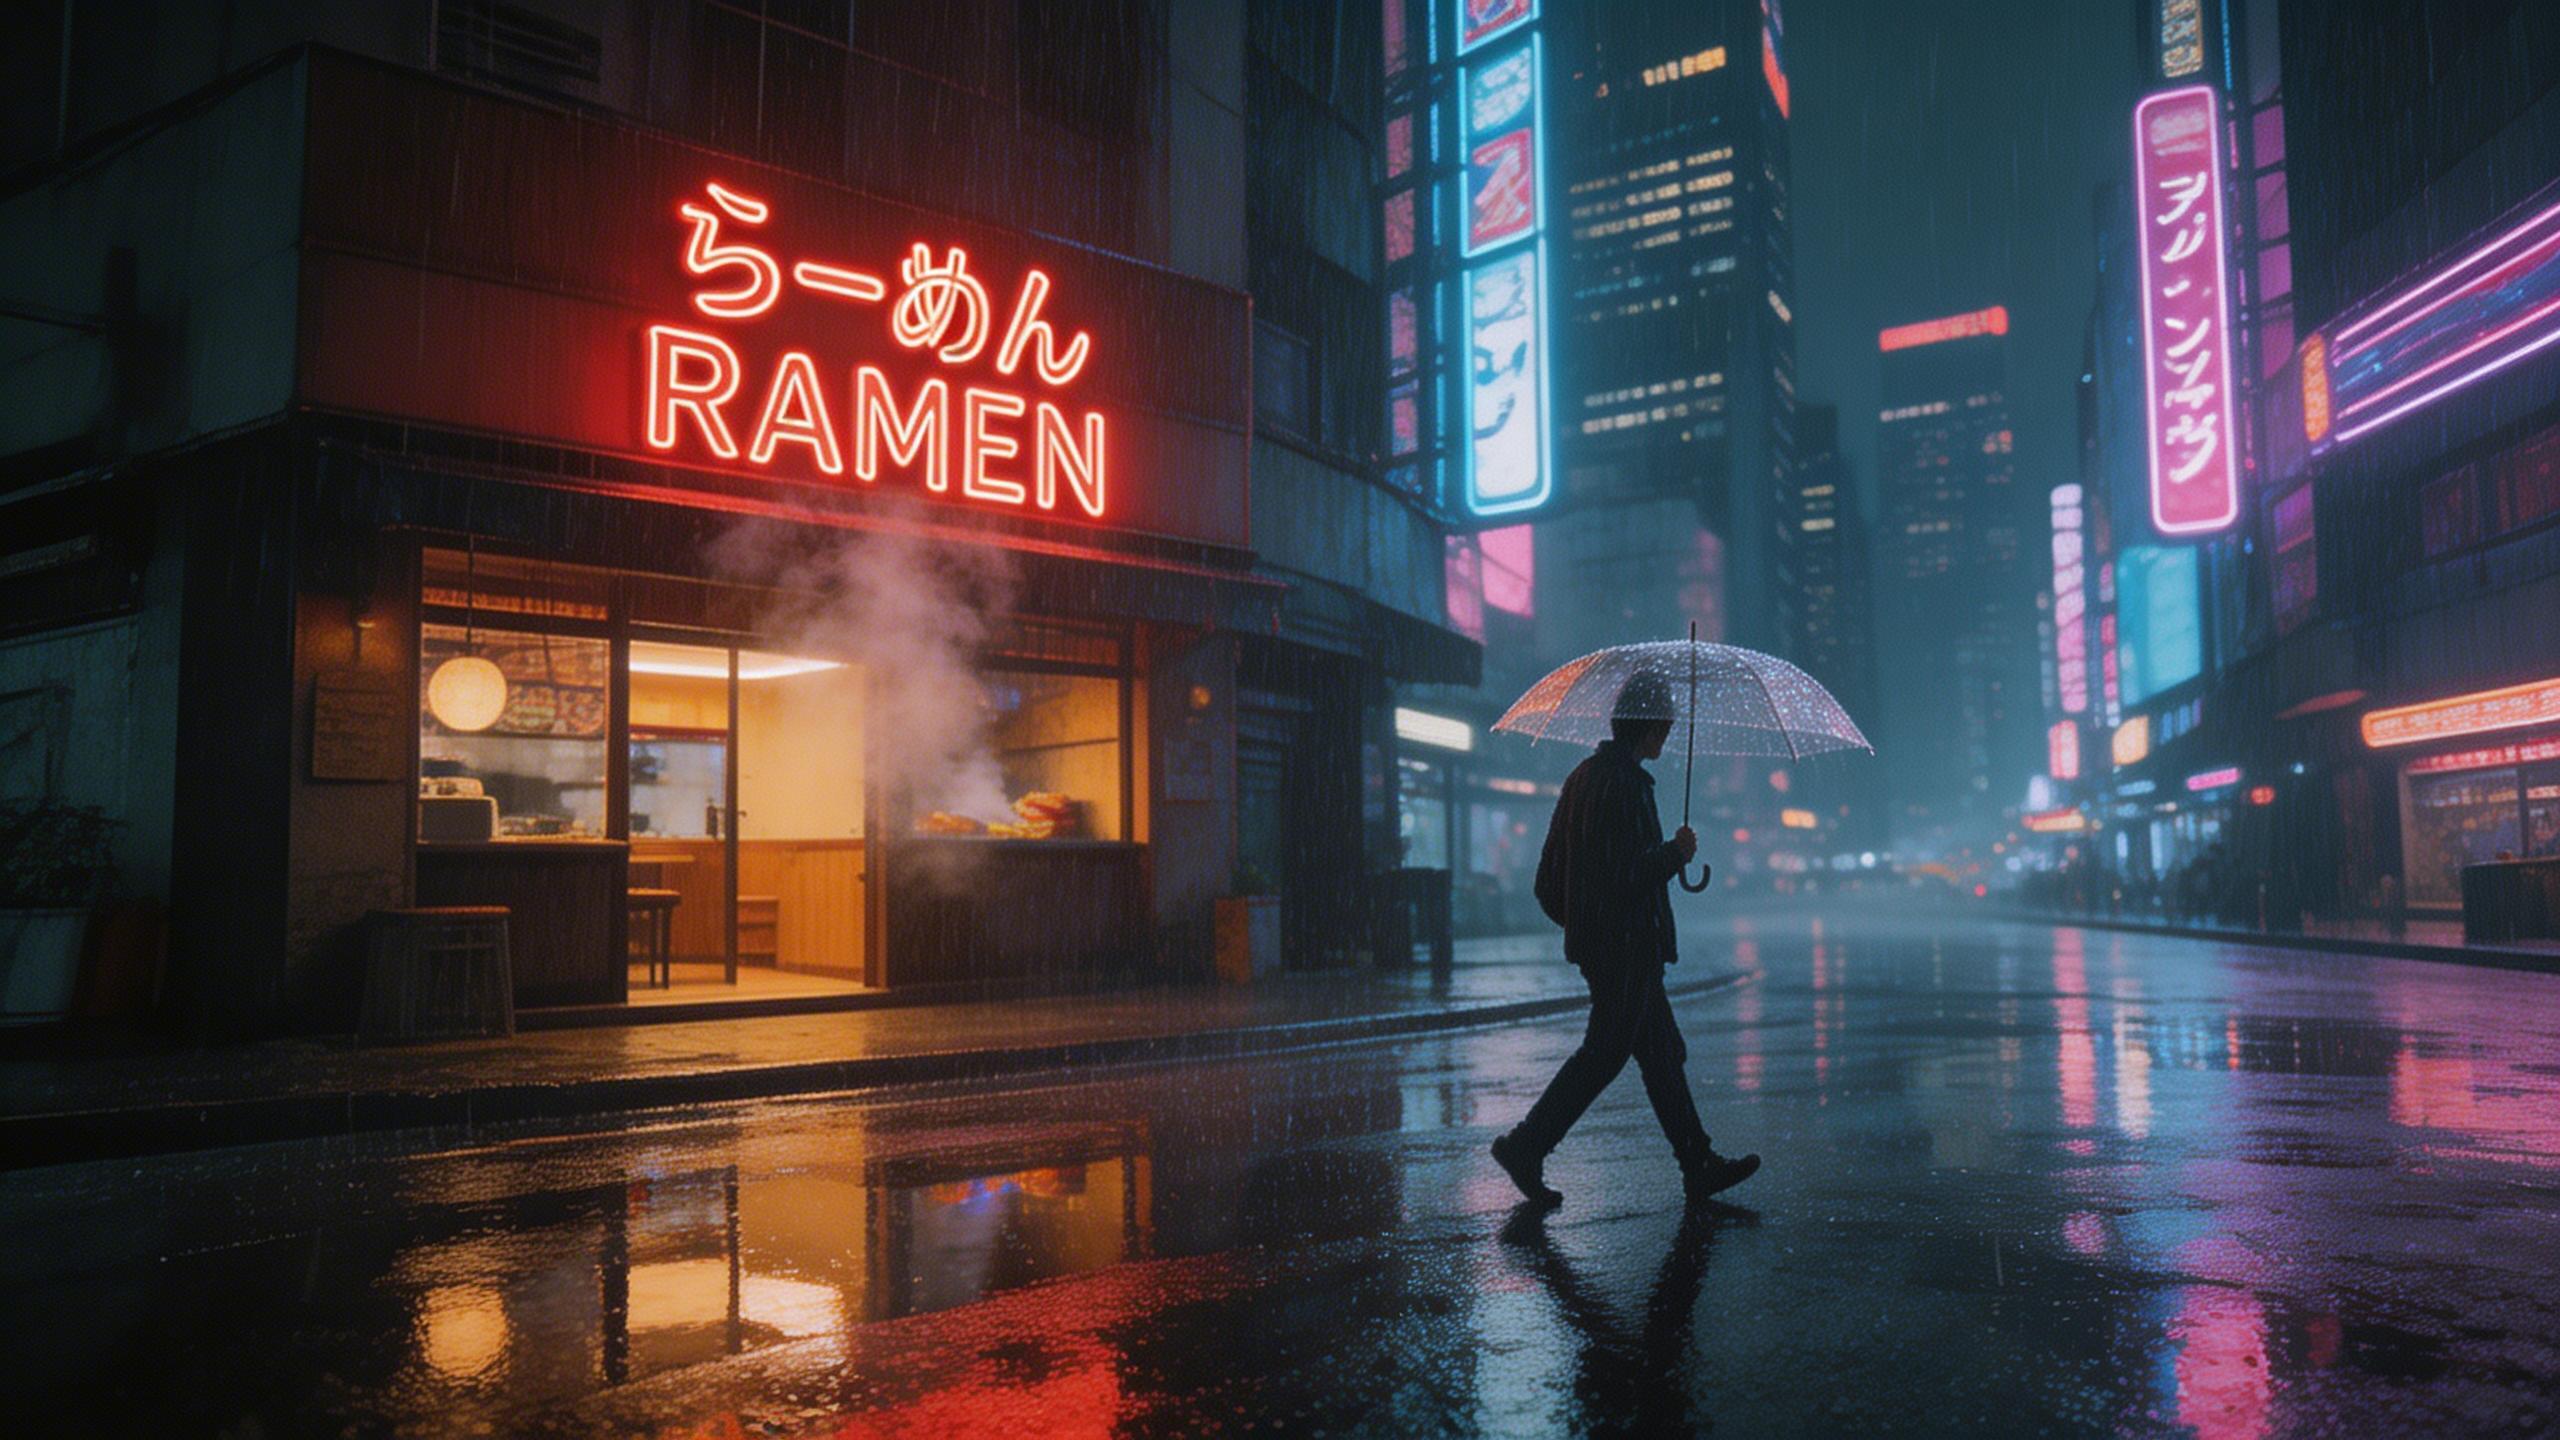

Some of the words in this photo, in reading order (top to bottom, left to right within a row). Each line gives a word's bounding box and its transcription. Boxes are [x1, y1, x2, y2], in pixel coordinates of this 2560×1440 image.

[680, 182, 1091, 386] らーめん
[647, 324, 1106, 518] RAMEN
